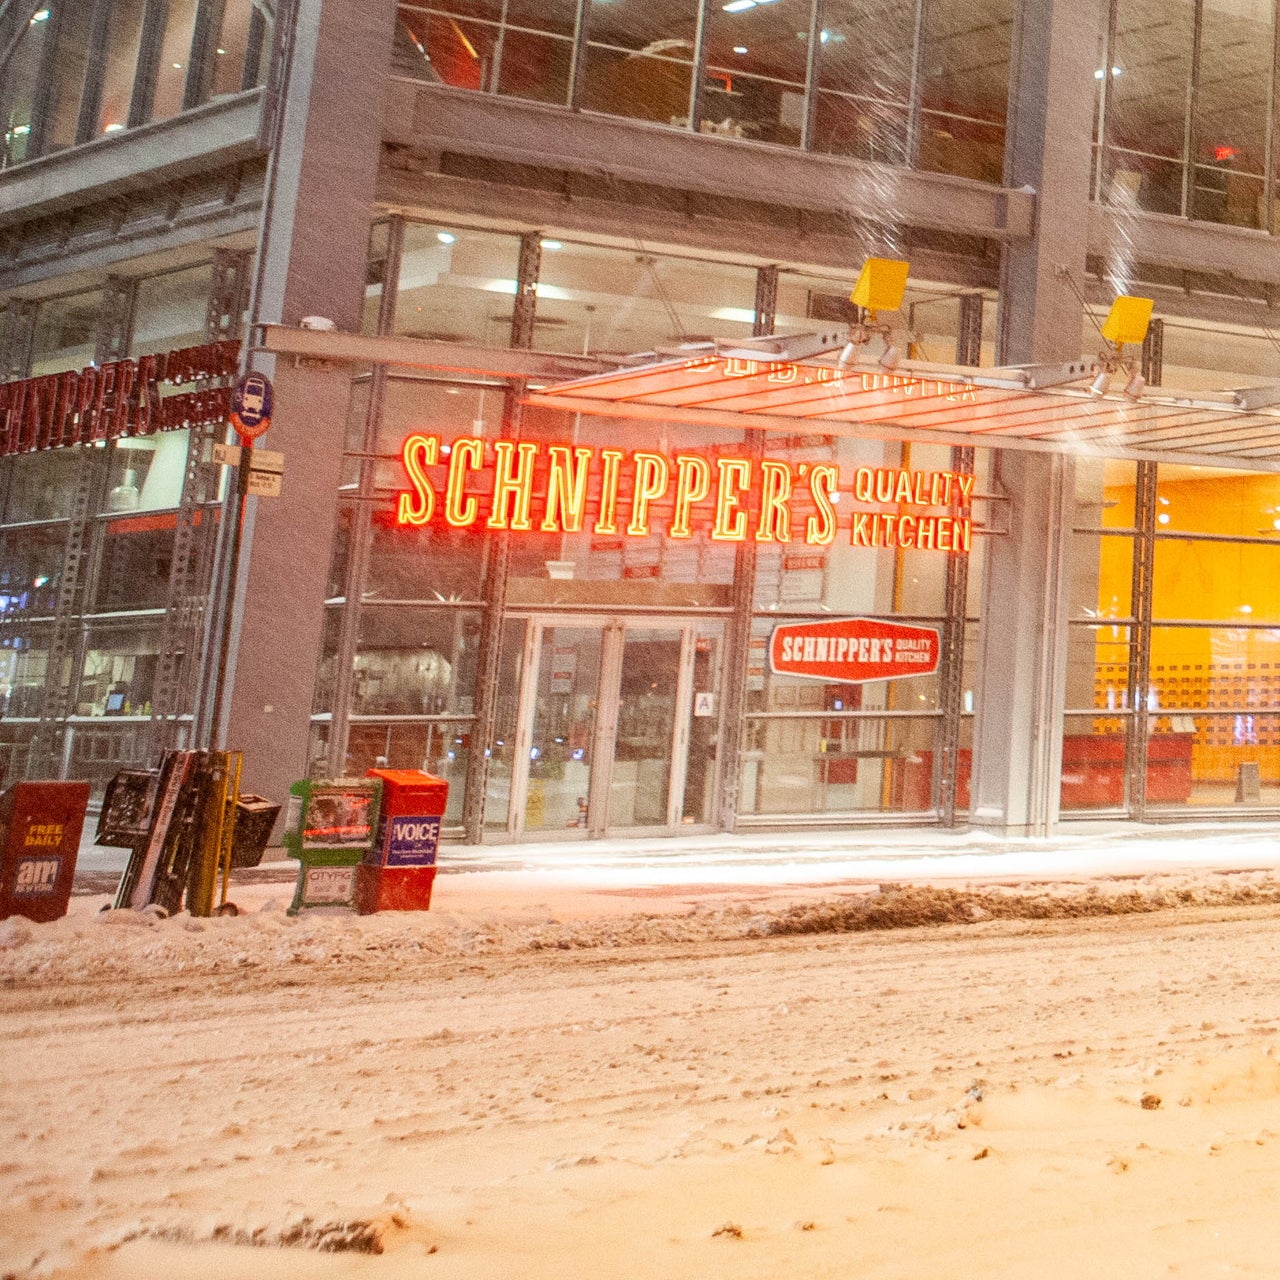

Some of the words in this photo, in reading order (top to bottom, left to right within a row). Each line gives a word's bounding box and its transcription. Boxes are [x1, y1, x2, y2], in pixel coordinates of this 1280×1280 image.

[398, 434, 839, 546] SCHNIPPER'S
[855, 467, 974, 507] QUALITY
[852, 512, 972, 551] KITCHEN
[782, 636, 893, 663] SCHNIPPER'S
[895, 638, 931, 651] QUALITY
[895, 651, 931, 664] KITCHEN
[29, 824, 64, 835] FREE
[395, 822, 438, 841] VOICE
[24, 834, 63, 847] DAILY
